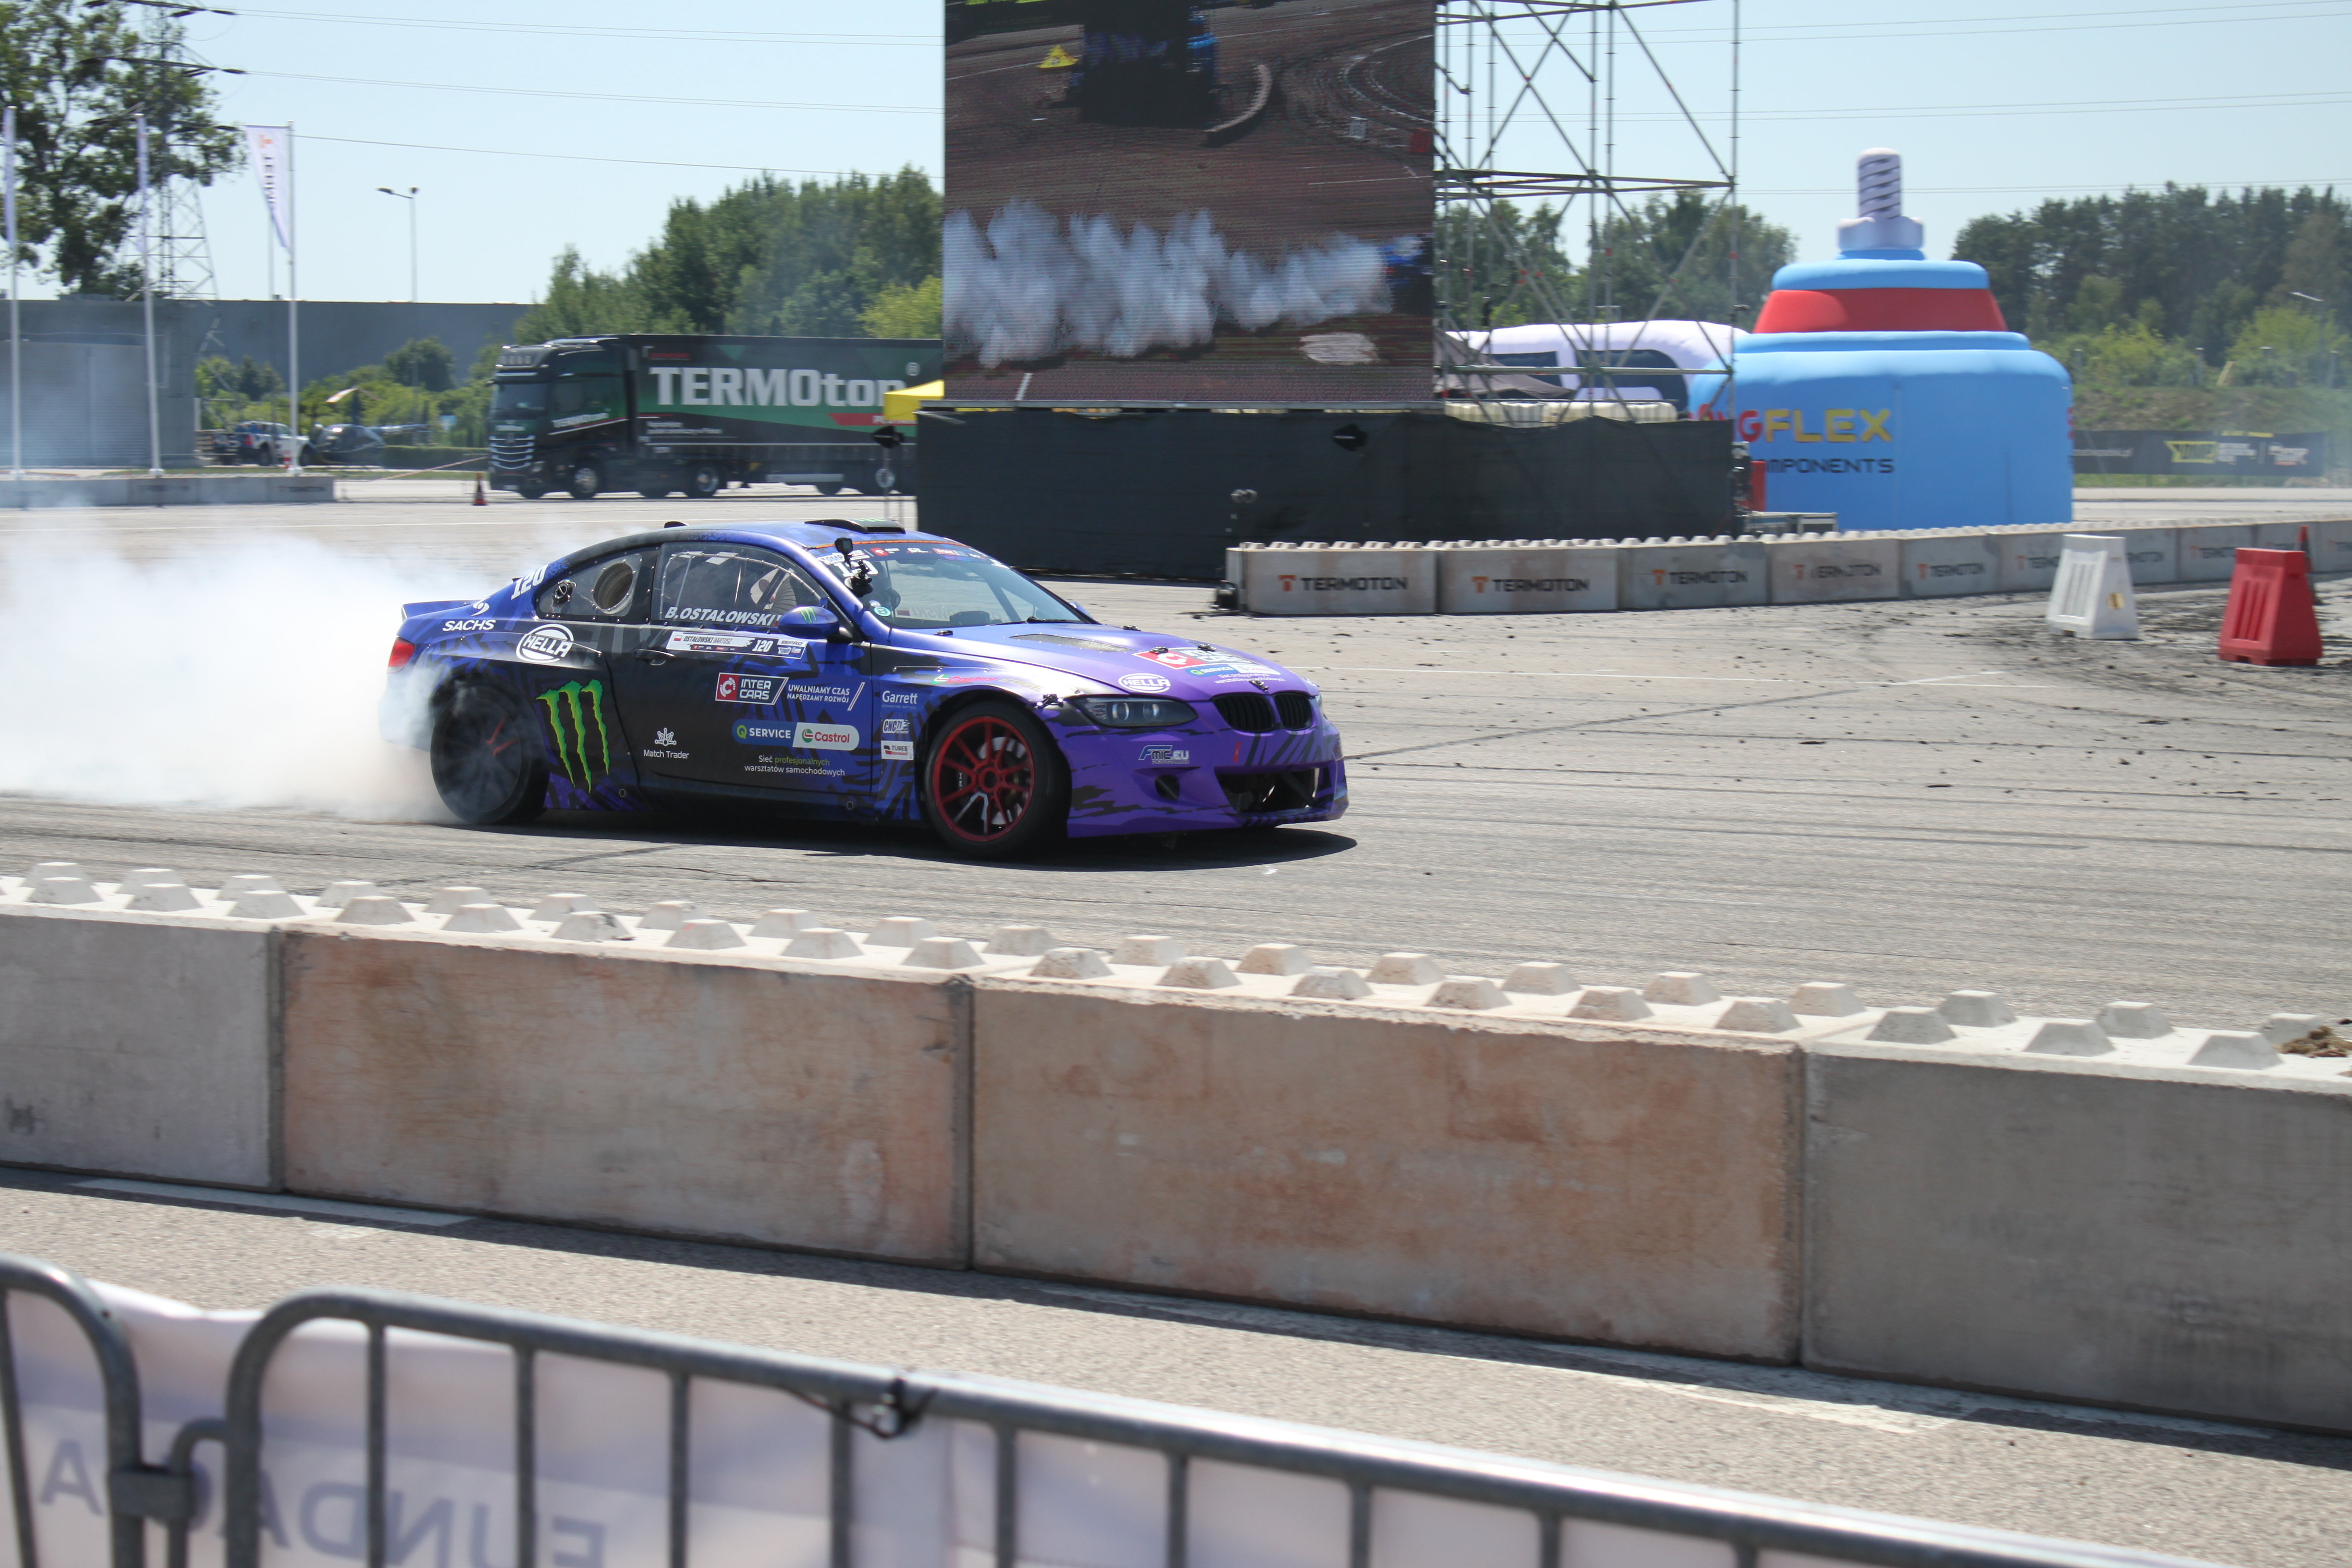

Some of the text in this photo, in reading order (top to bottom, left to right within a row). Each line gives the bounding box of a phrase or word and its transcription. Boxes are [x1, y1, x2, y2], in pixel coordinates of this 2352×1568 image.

[1758, 458, 1895, 474] MPONENTS
[511, 564, 549, 600] 120
[1300, 577, 1409, 590] TERMOTON
[1492, 579, 1590, 592] TERMOTON
[665, 607, 776, 626] B.OSTAŁOWSKI
[442, 620, 496, 631] SACHS
[523, 635, 573, 657] HELLA
[752, 639, 774, 652] 120
[740, 679, 772, 689] INTER
[998, 678, 1046, 691] EDGE
[1124, 679, 1171, 687] HELLA
[739, 689, 770, 700] CARS
[788, 685, 850, 695] UWALNIAMY CZAS
[787, 693, 823, 702] NAPĘDZAMY
[882, 690, 918, 704] Garrett
[883, 720, 902, 732] CNC71
[749, 728, 791, 738] SERVICE
[815, 732, 850, 743] Castrol
[666, 750, 689, 759] Trader
[775, 756, 830, 766] profesjonalnych
[785, 767, 845, 777] samochodowych
